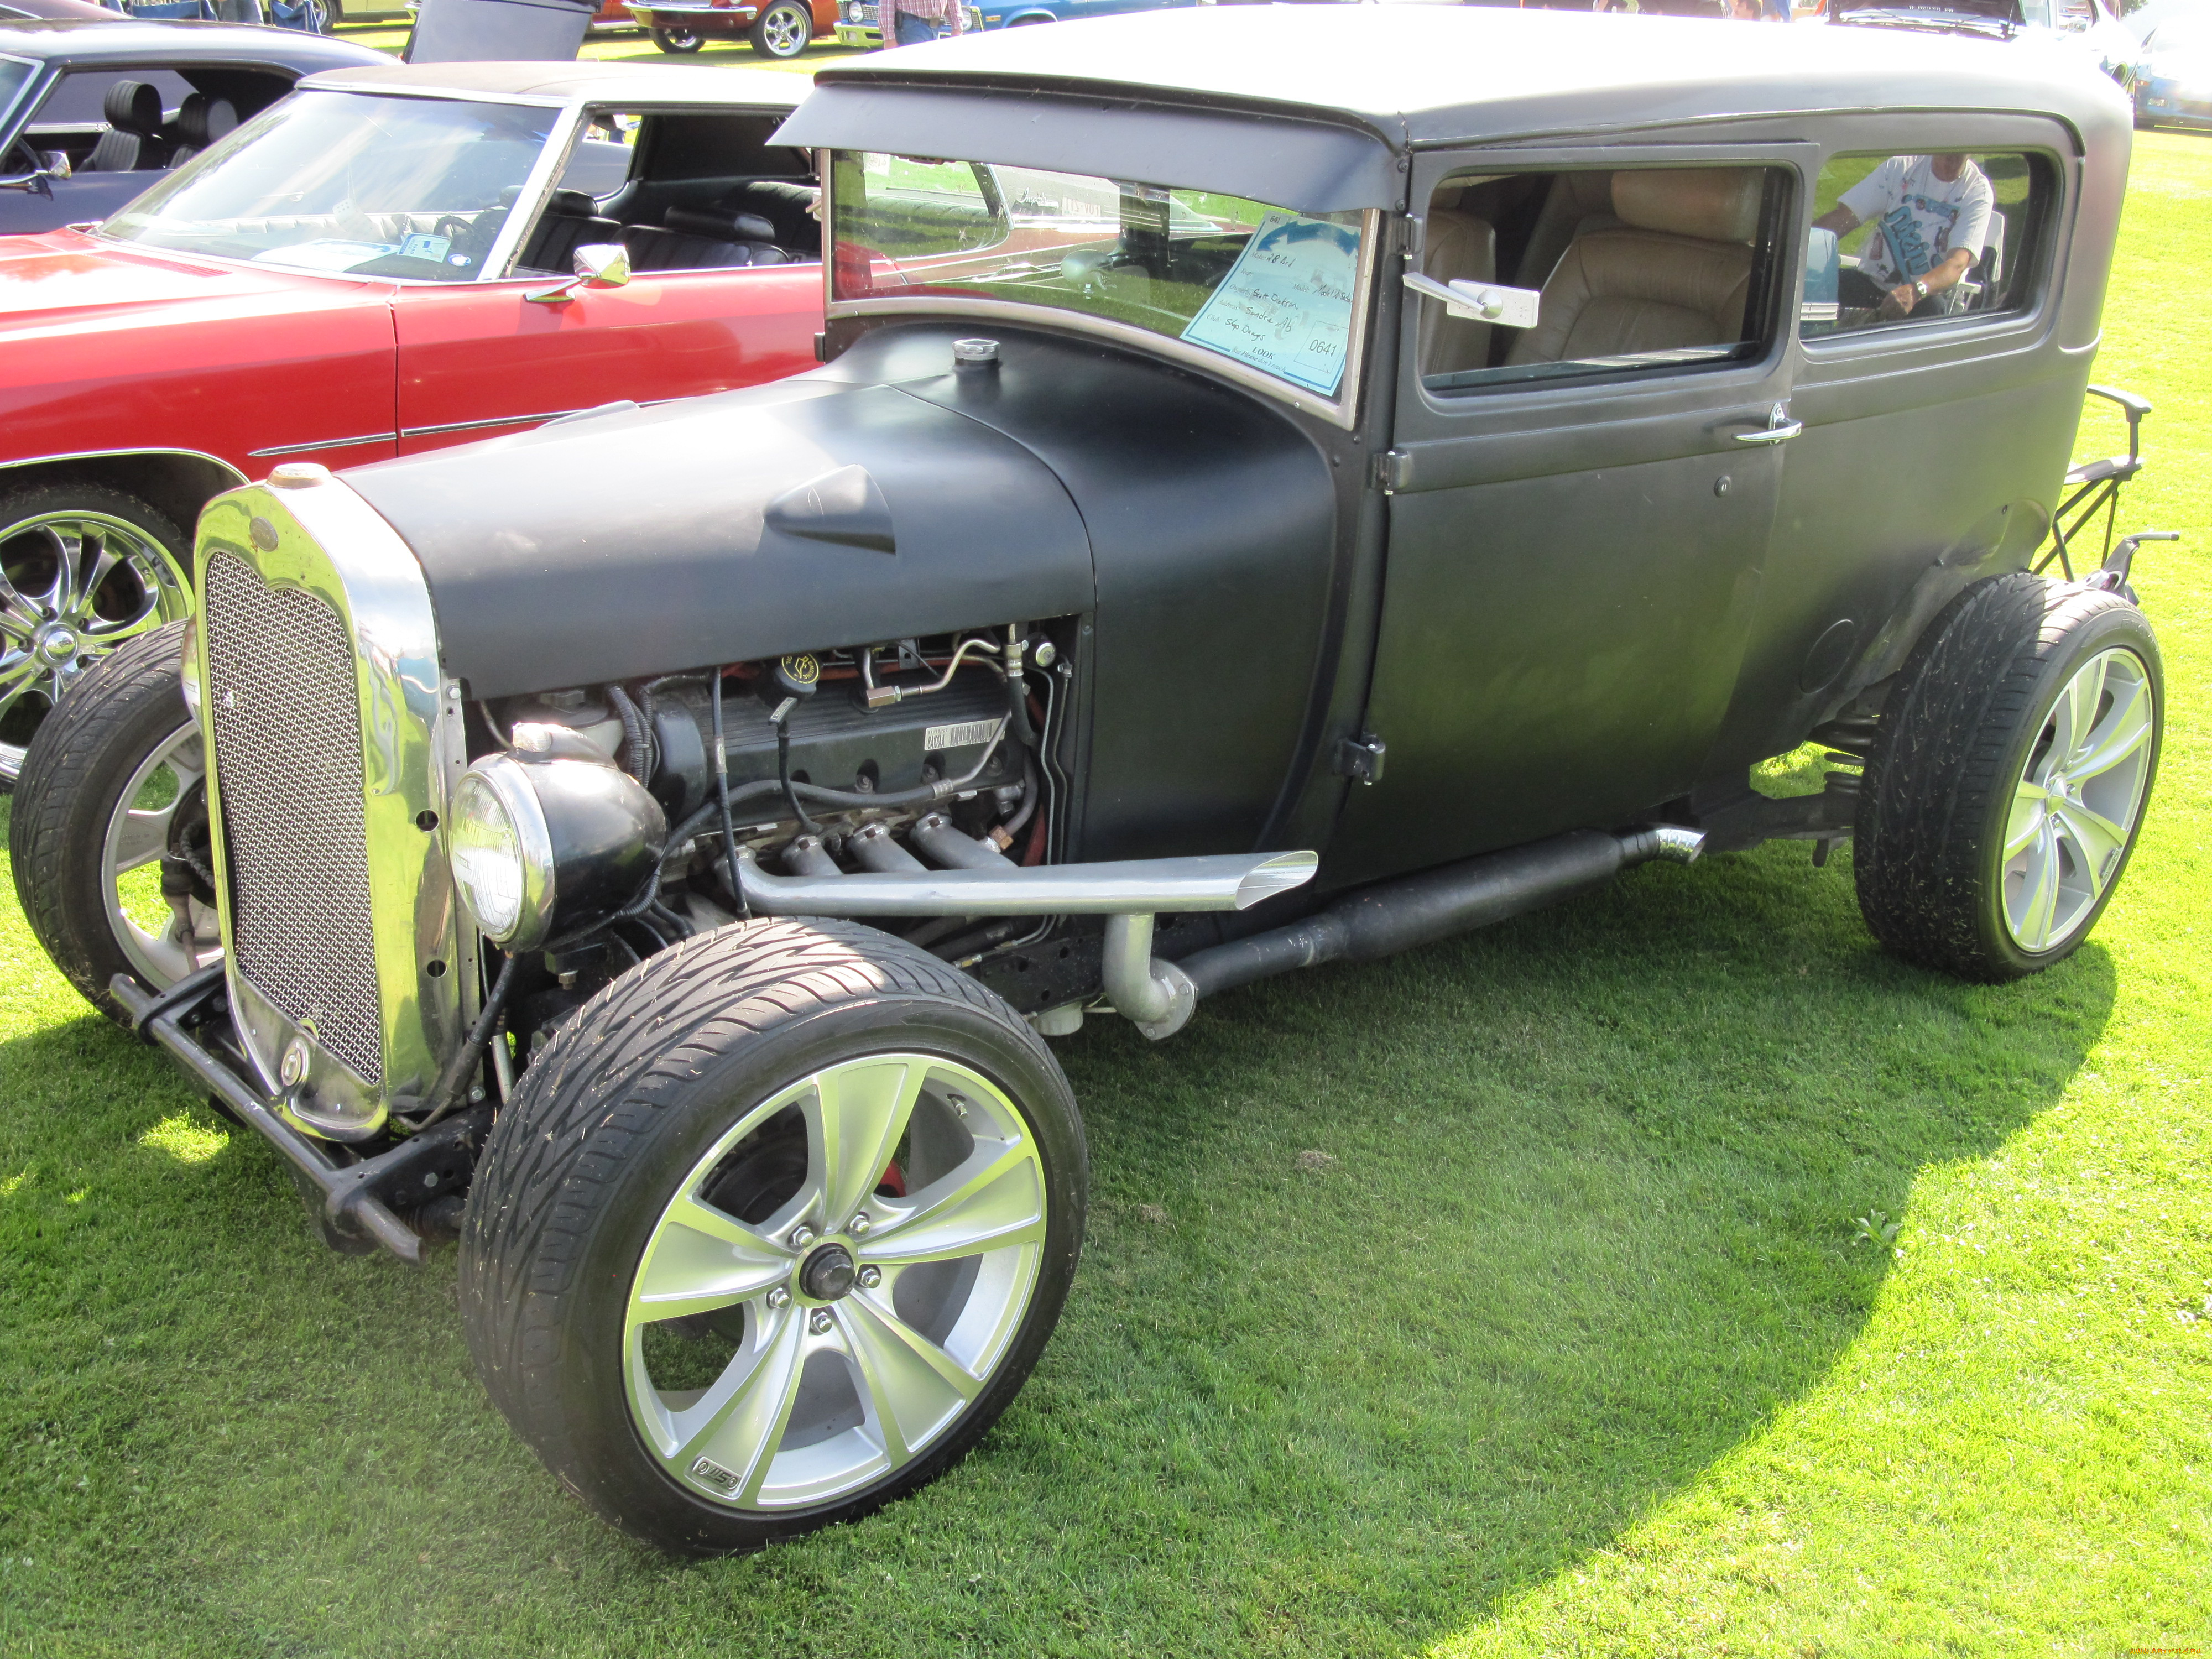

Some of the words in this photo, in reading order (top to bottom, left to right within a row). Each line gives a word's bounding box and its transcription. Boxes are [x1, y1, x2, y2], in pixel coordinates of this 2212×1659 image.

[1270, 215, 1281, 224] 641
[1251, 346, 1276, 360] LOOK
[1309, 339, 1337, 357] 0641
[1241, 351, 1259, 361] Please
[802, 660, 815, 680] ENGINE
